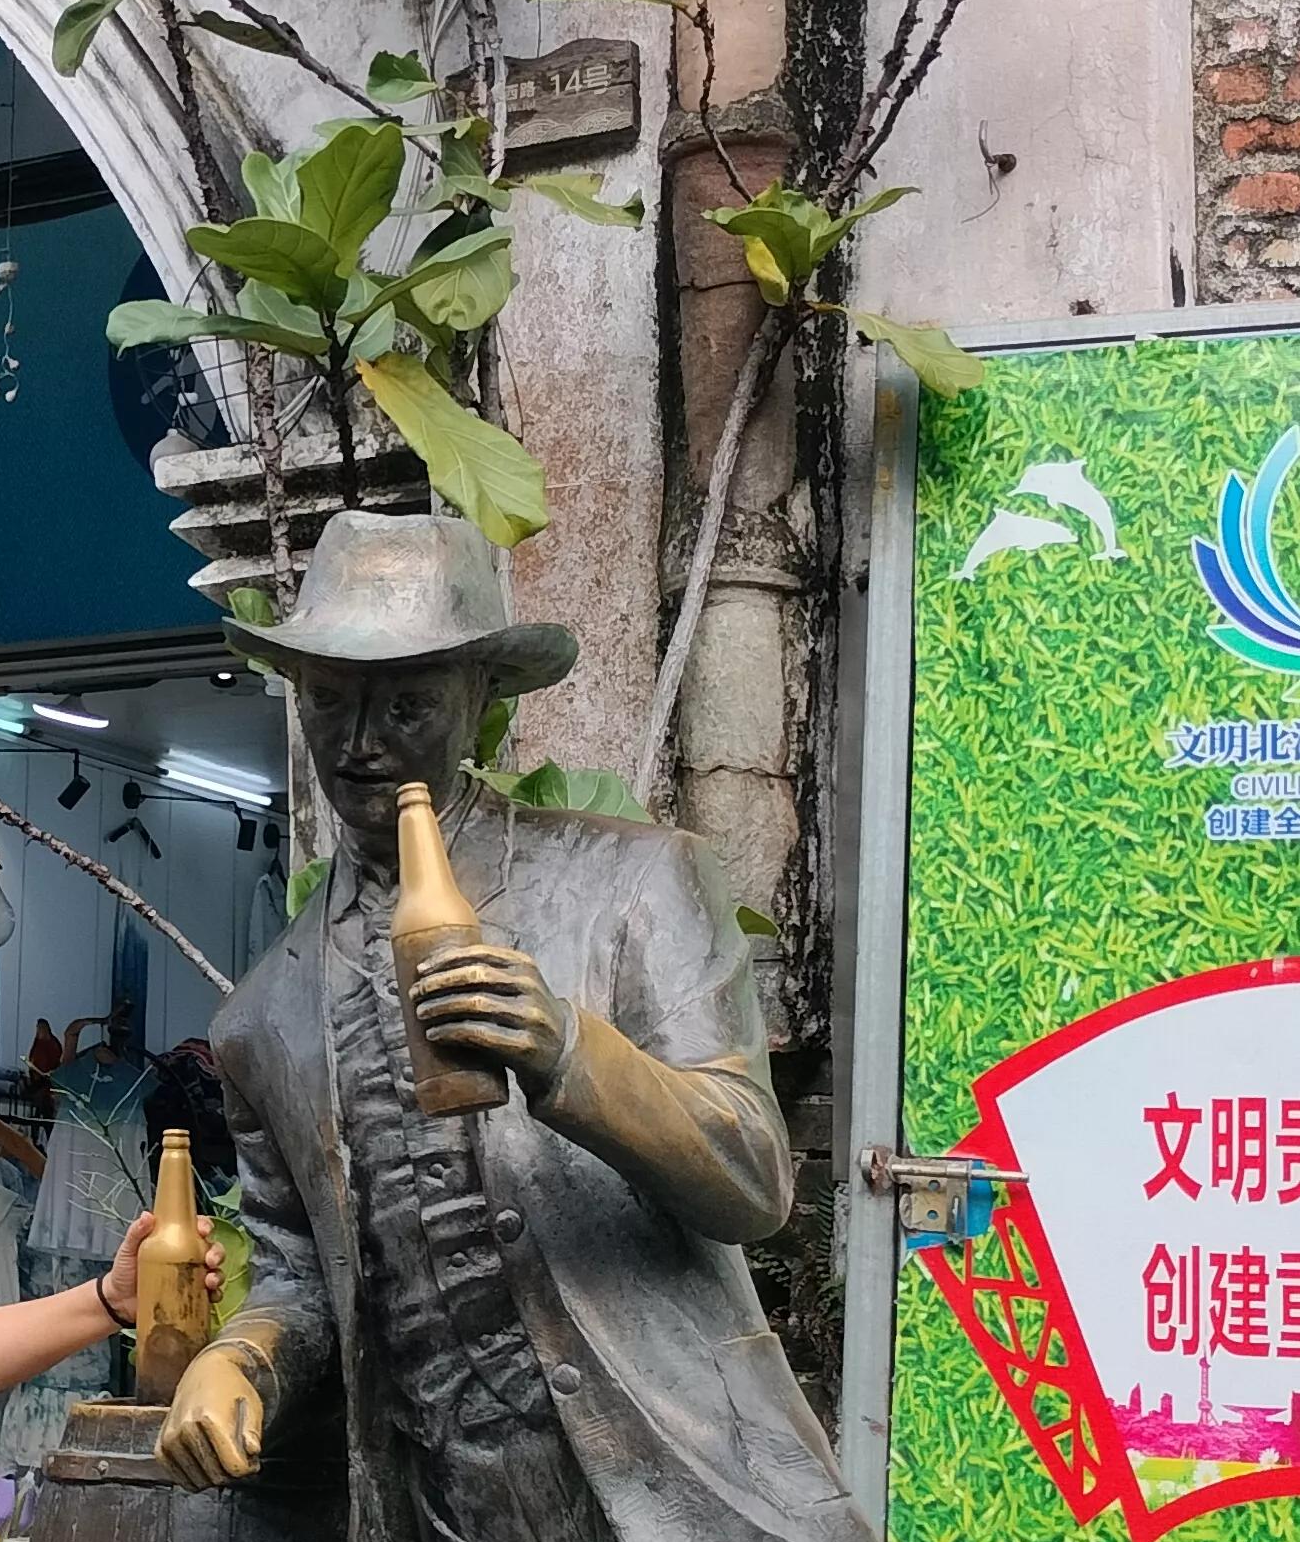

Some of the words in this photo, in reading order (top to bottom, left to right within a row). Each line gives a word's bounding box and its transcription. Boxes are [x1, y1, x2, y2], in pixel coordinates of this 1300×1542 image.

[550, 64, 612, 96] 14号
[1164, 721, 1300, 766] 文明北
